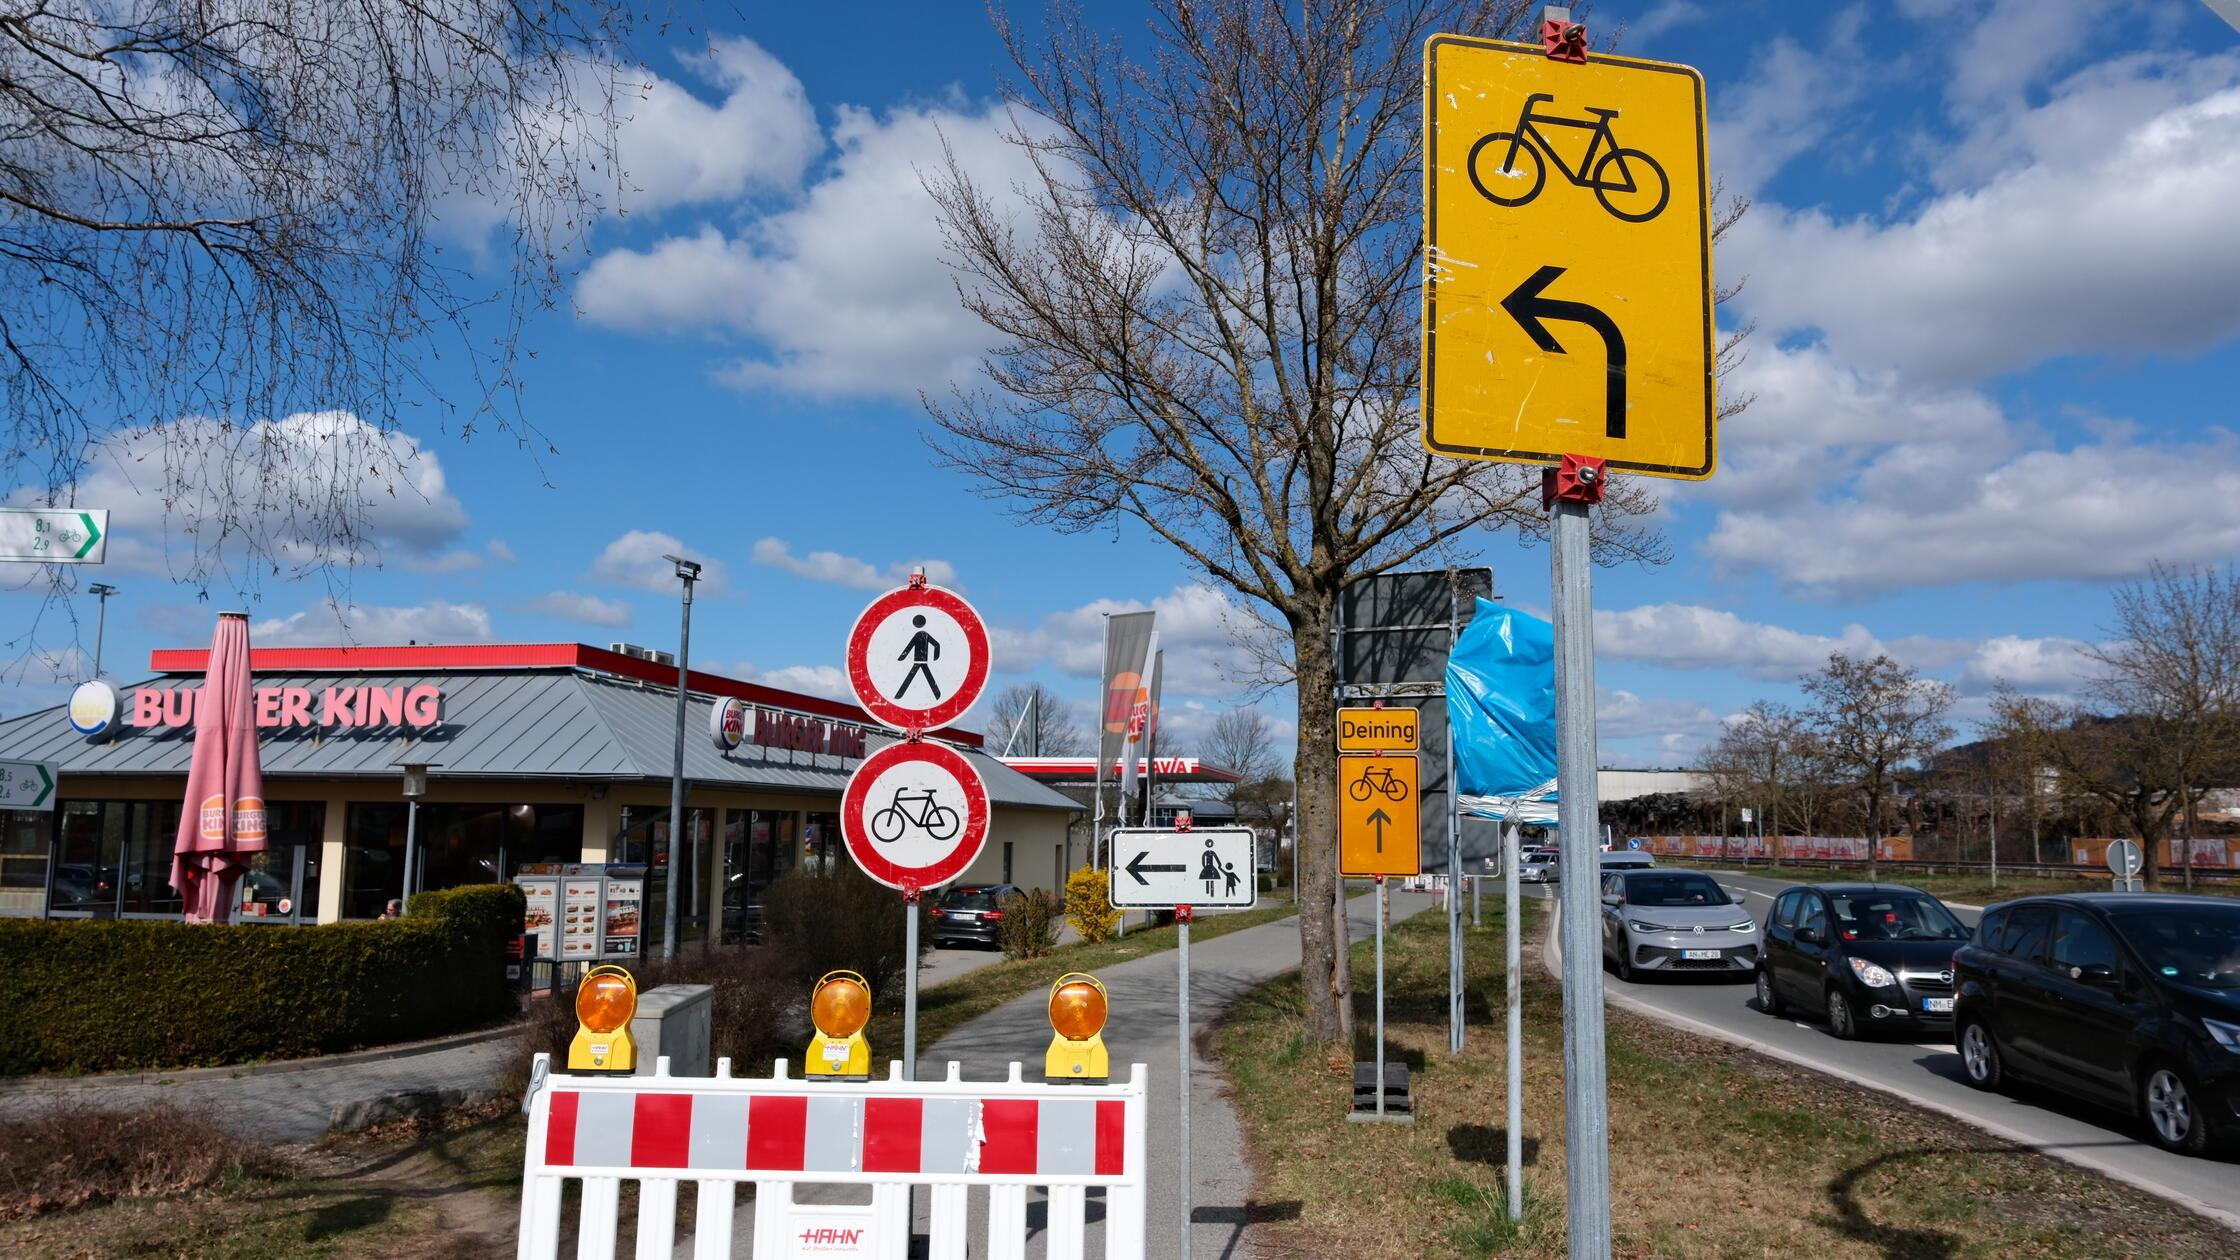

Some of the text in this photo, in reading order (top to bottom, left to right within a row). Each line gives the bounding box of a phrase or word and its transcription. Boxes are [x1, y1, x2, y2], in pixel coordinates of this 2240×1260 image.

[133, 688, 312, 728] BUER
[322, 684, 440, 728] KING
[753, 709, 867, 760] BURGER KING
[1342, 720, 1415, 743] Deining
[798, 1228, 865, 1245] HAHN
